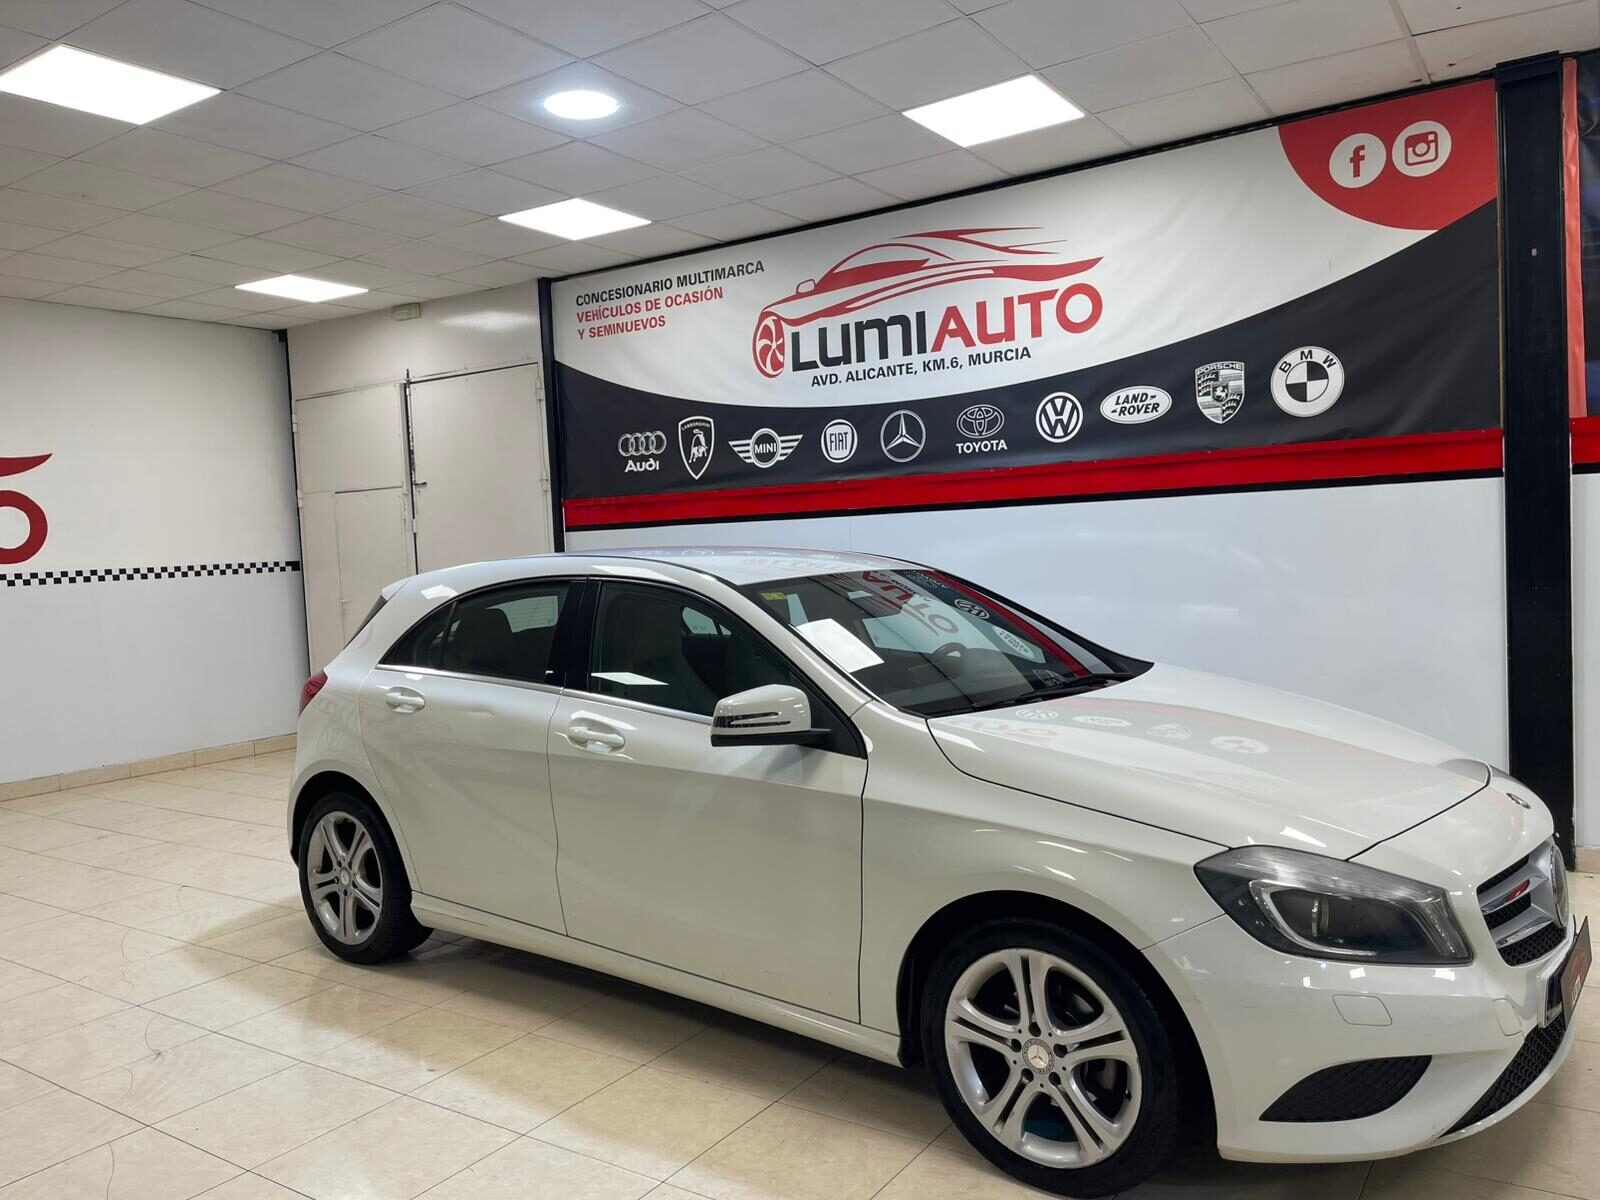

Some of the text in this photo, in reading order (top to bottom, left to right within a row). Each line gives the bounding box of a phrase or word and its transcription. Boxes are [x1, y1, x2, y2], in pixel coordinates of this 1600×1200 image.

[576, 260, 765, 307] CONCESIONARIO MULTIMARCA
[576, 285, 724, 324] VEHÍCULOS DE OCASIÓN
[577, 315, 666, 340] Y SEMINUEVOS
[811, 346, 1032, 388] AVD. ALICANTE, KM.6, MURCIA
[1196, 362, 1242, 376] PORSCHE
[1278, 349, 1337, 374] BMW
[753, 441, 777, 455] MINI
[829, 430, 849, 450] FIAT
[956, 439, 1008, 454] TOYOTA
[624, 458, 660, 473] Audi
